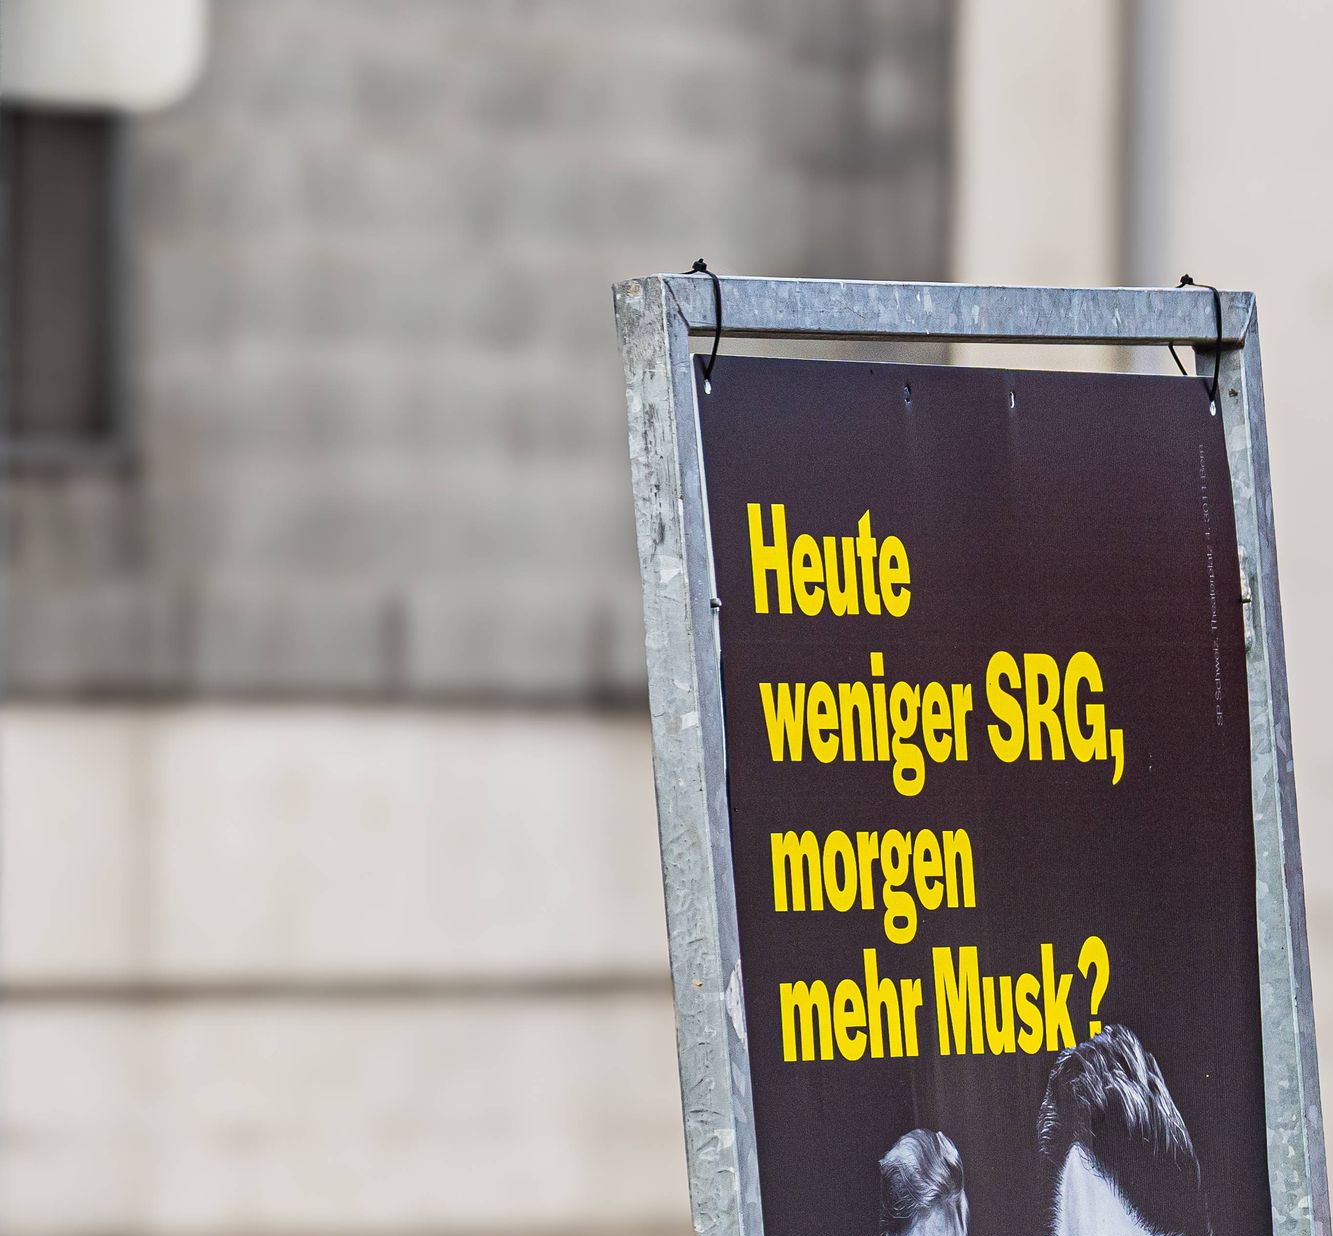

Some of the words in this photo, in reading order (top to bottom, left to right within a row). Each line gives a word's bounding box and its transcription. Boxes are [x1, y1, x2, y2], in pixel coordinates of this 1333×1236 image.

[746, 502, 912, 618] Heute
[758, 651, 974, 797] weniger
[985, 650, 1126, 785] SRG,
[770, 828, 977, 944] morgen
[779, 948, 923, 1062] mehr
[931, 935, 1110, 1057] Musk?
